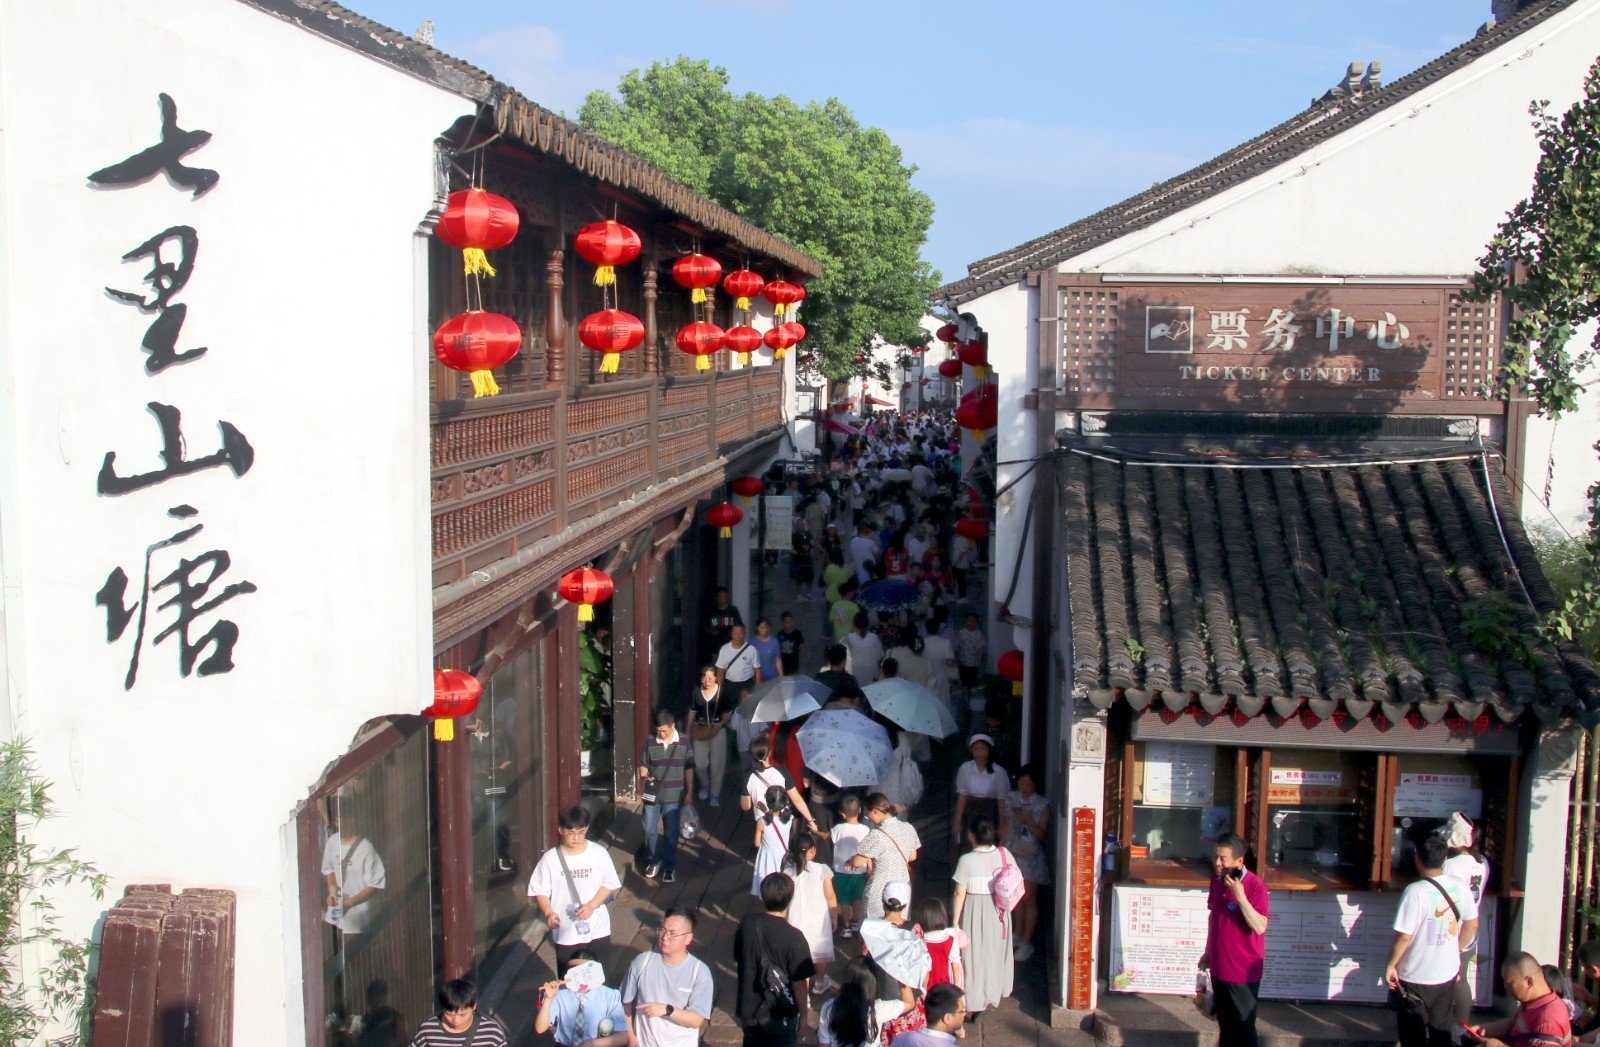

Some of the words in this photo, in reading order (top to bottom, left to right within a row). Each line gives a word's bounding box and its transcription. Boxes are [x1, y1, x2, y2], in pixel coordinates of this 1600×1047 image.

[1206, 308, 1410, 351] 票务中心
[88, 93, 257, 689] 七里山塘
[1179, 365, 1271, 381] TICKET
[1282, 366, 1381, 382] CENTER
